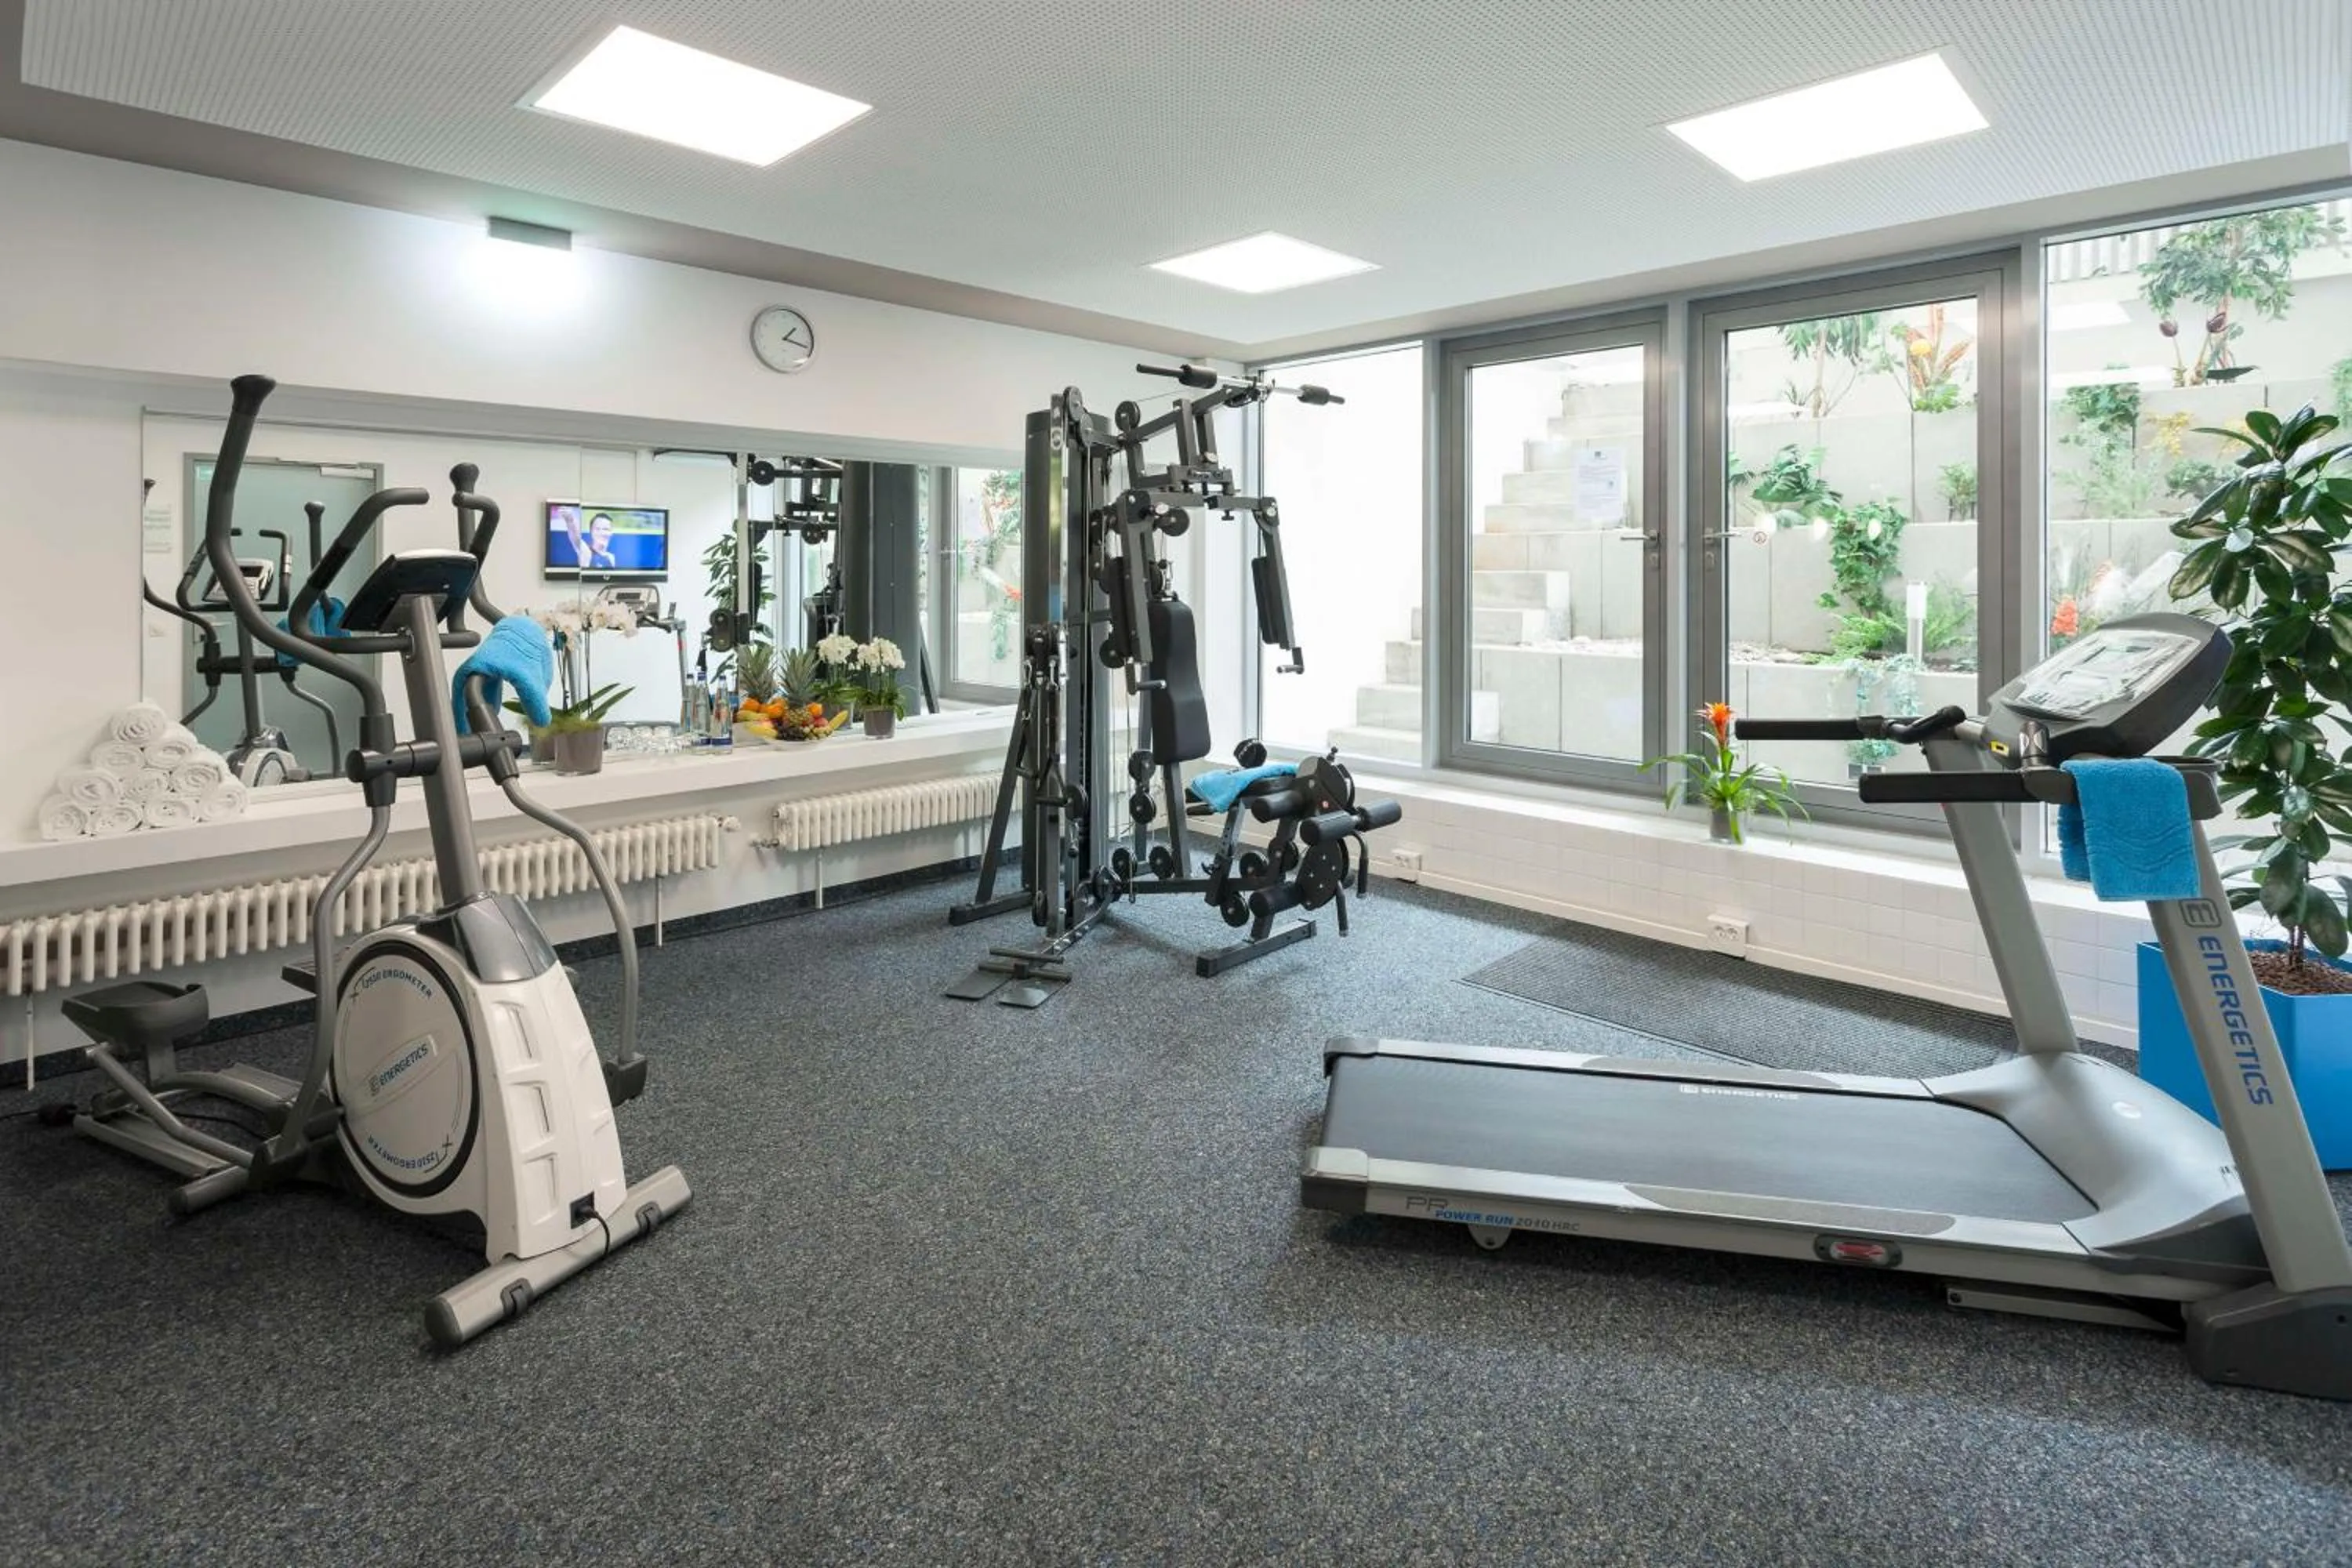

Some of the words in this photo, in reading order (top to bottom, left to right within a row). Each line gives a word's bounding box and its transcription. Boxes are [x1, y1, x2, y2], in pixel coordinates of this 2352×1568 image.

[383, 969, 432, 1000] ERGOMETER
[2198, 935, 2274, 1105] ENERGETICS
[379, 1043, 428, 1086] ENERGETICS
[368, 1134, 416, 1169] ERGOMETER
[1406, 1196, 1449, 1211] PR
[1435, 1209, 1482, 1222] POWER
[1486, 1214, 1514, 1225] RUN
[1515, 1217, 1552, 1229] 2010
[1552, 1221, 1580, 1232] HRC
